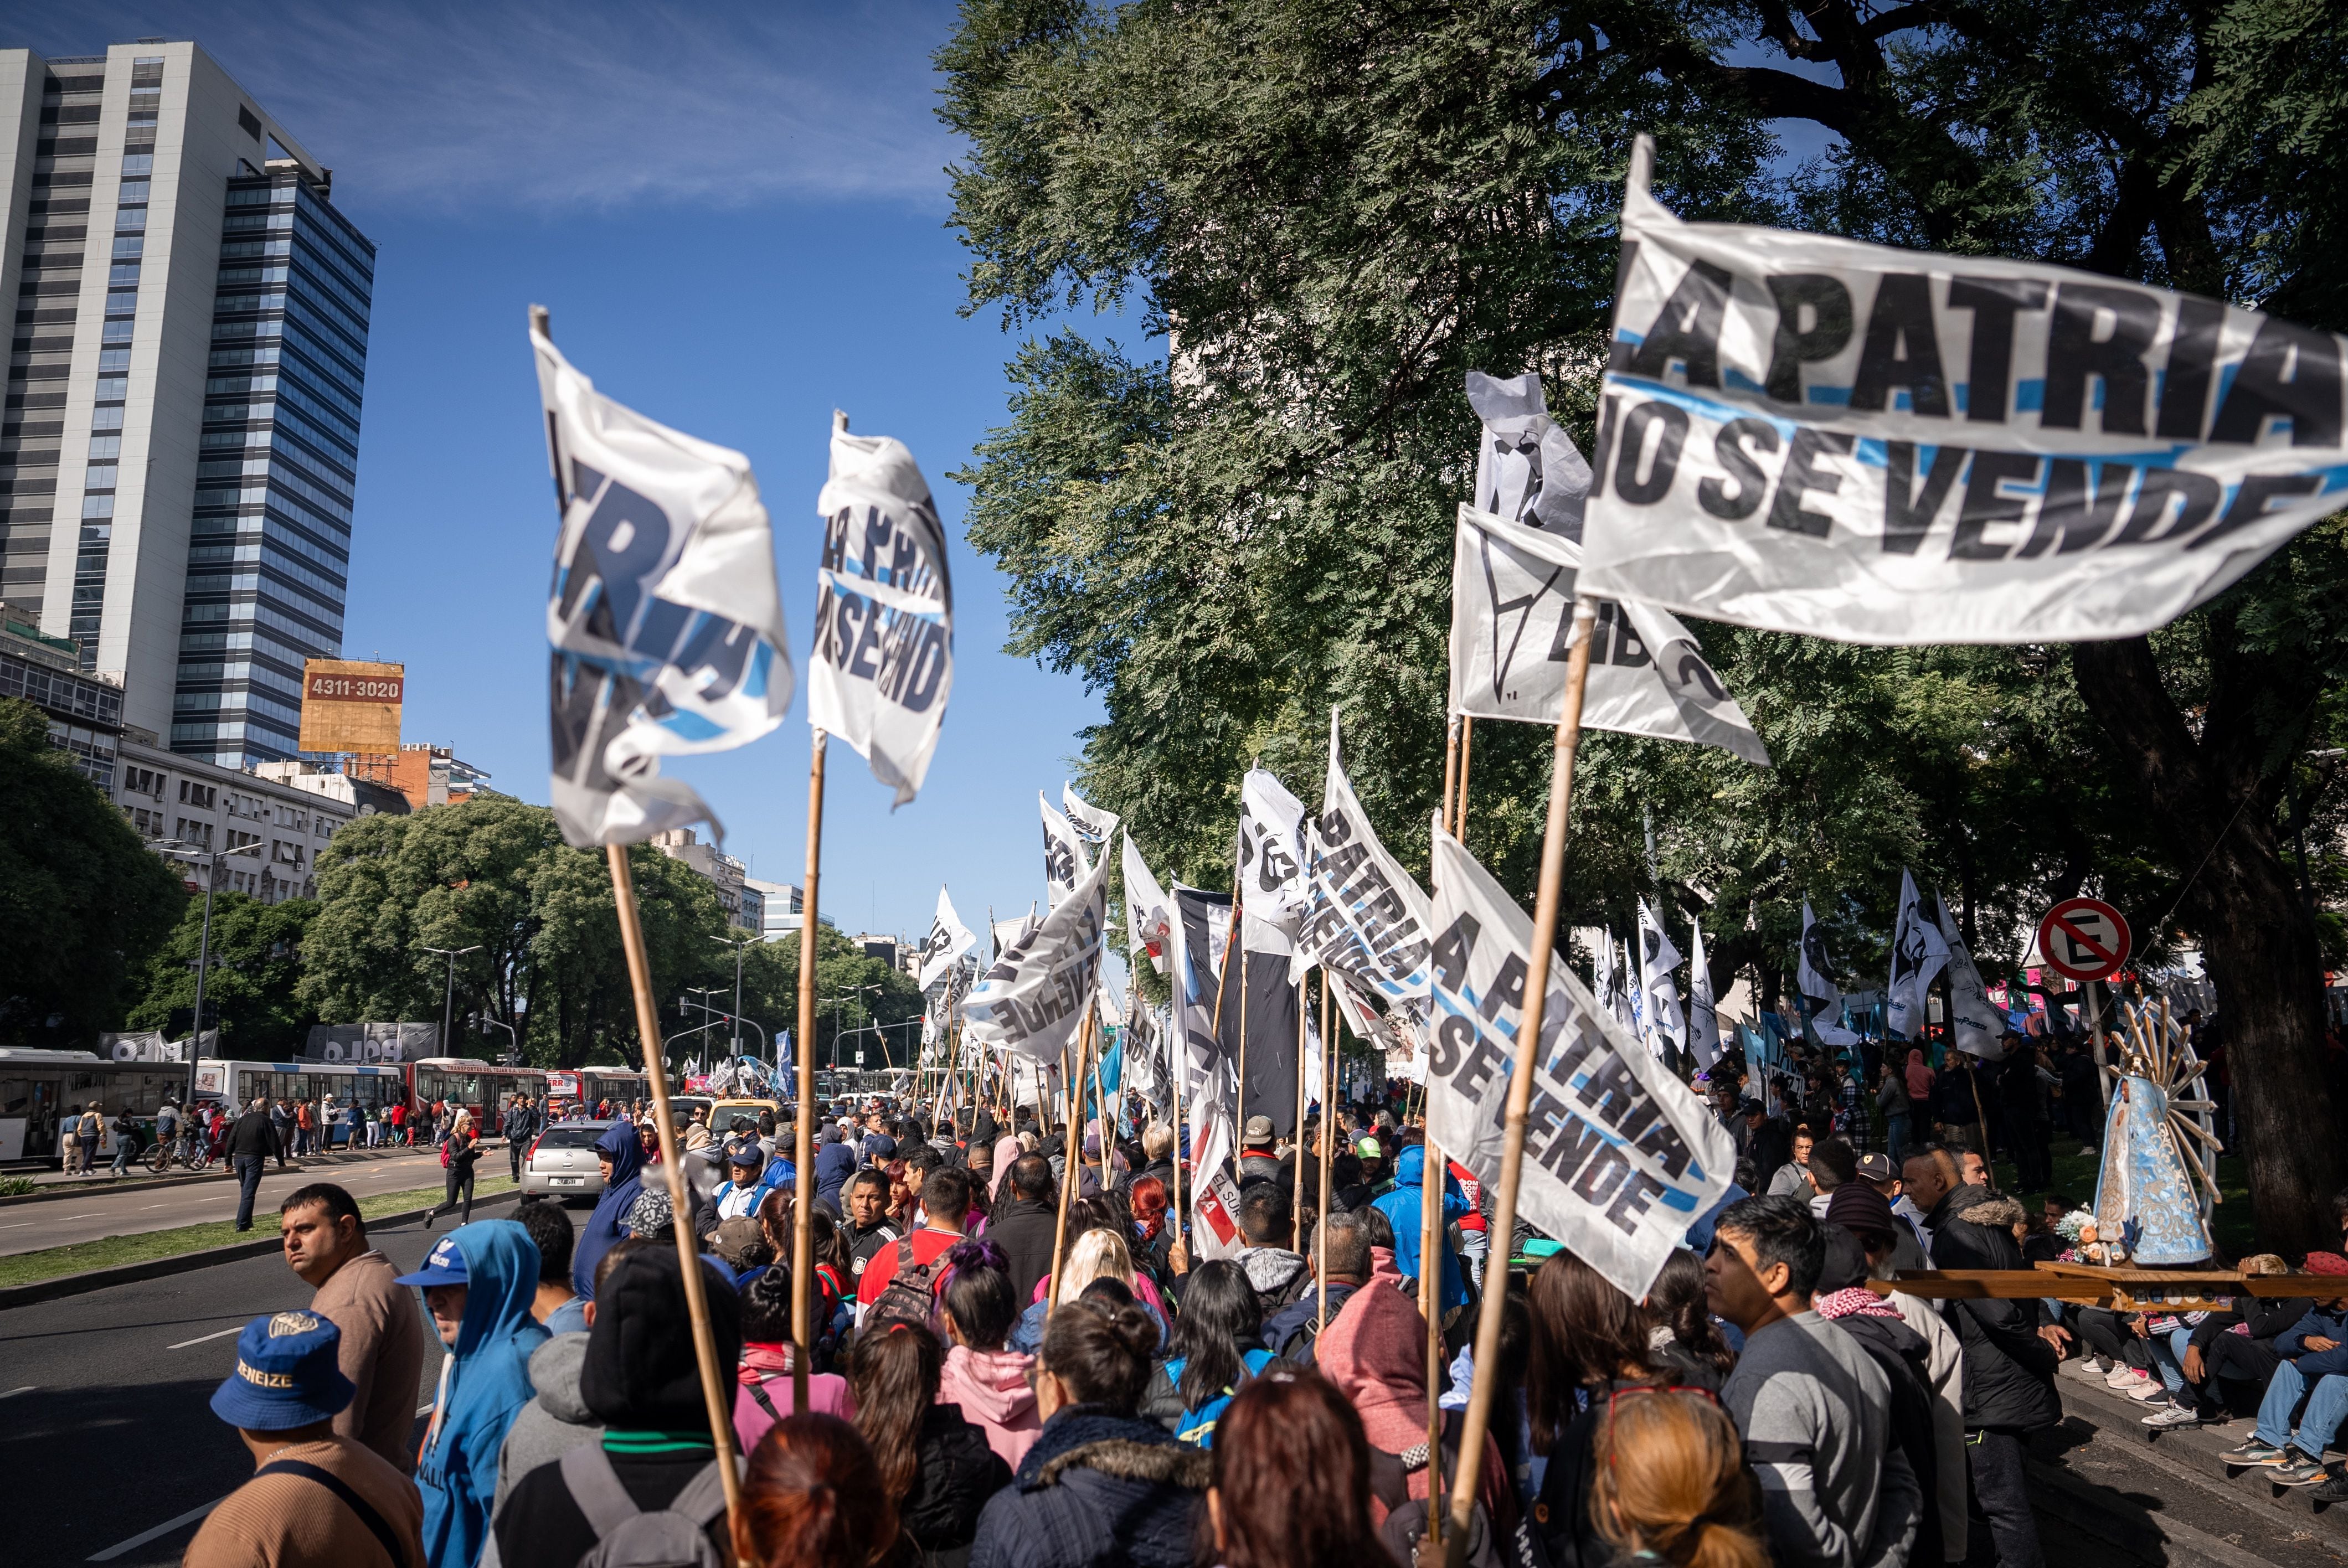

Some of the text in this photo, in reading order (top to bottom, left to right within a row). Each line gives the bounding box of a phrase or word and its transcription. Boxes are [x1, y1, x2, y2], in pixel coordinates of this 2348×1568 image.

[1610, 240, 2345, 450] A PATRIA
[1594, 394, 1689, 506] O
[1698, 417, 1861, 538] SE
[312, 679, 399, 698] 4311-3020
[1319, 807, 1432, 981] PATRIA
[2064, 915, 2106, 964] E
[1429, 1015, 1509, 1105] SE
[1478, 951, 1696, 1180] PATRIA
